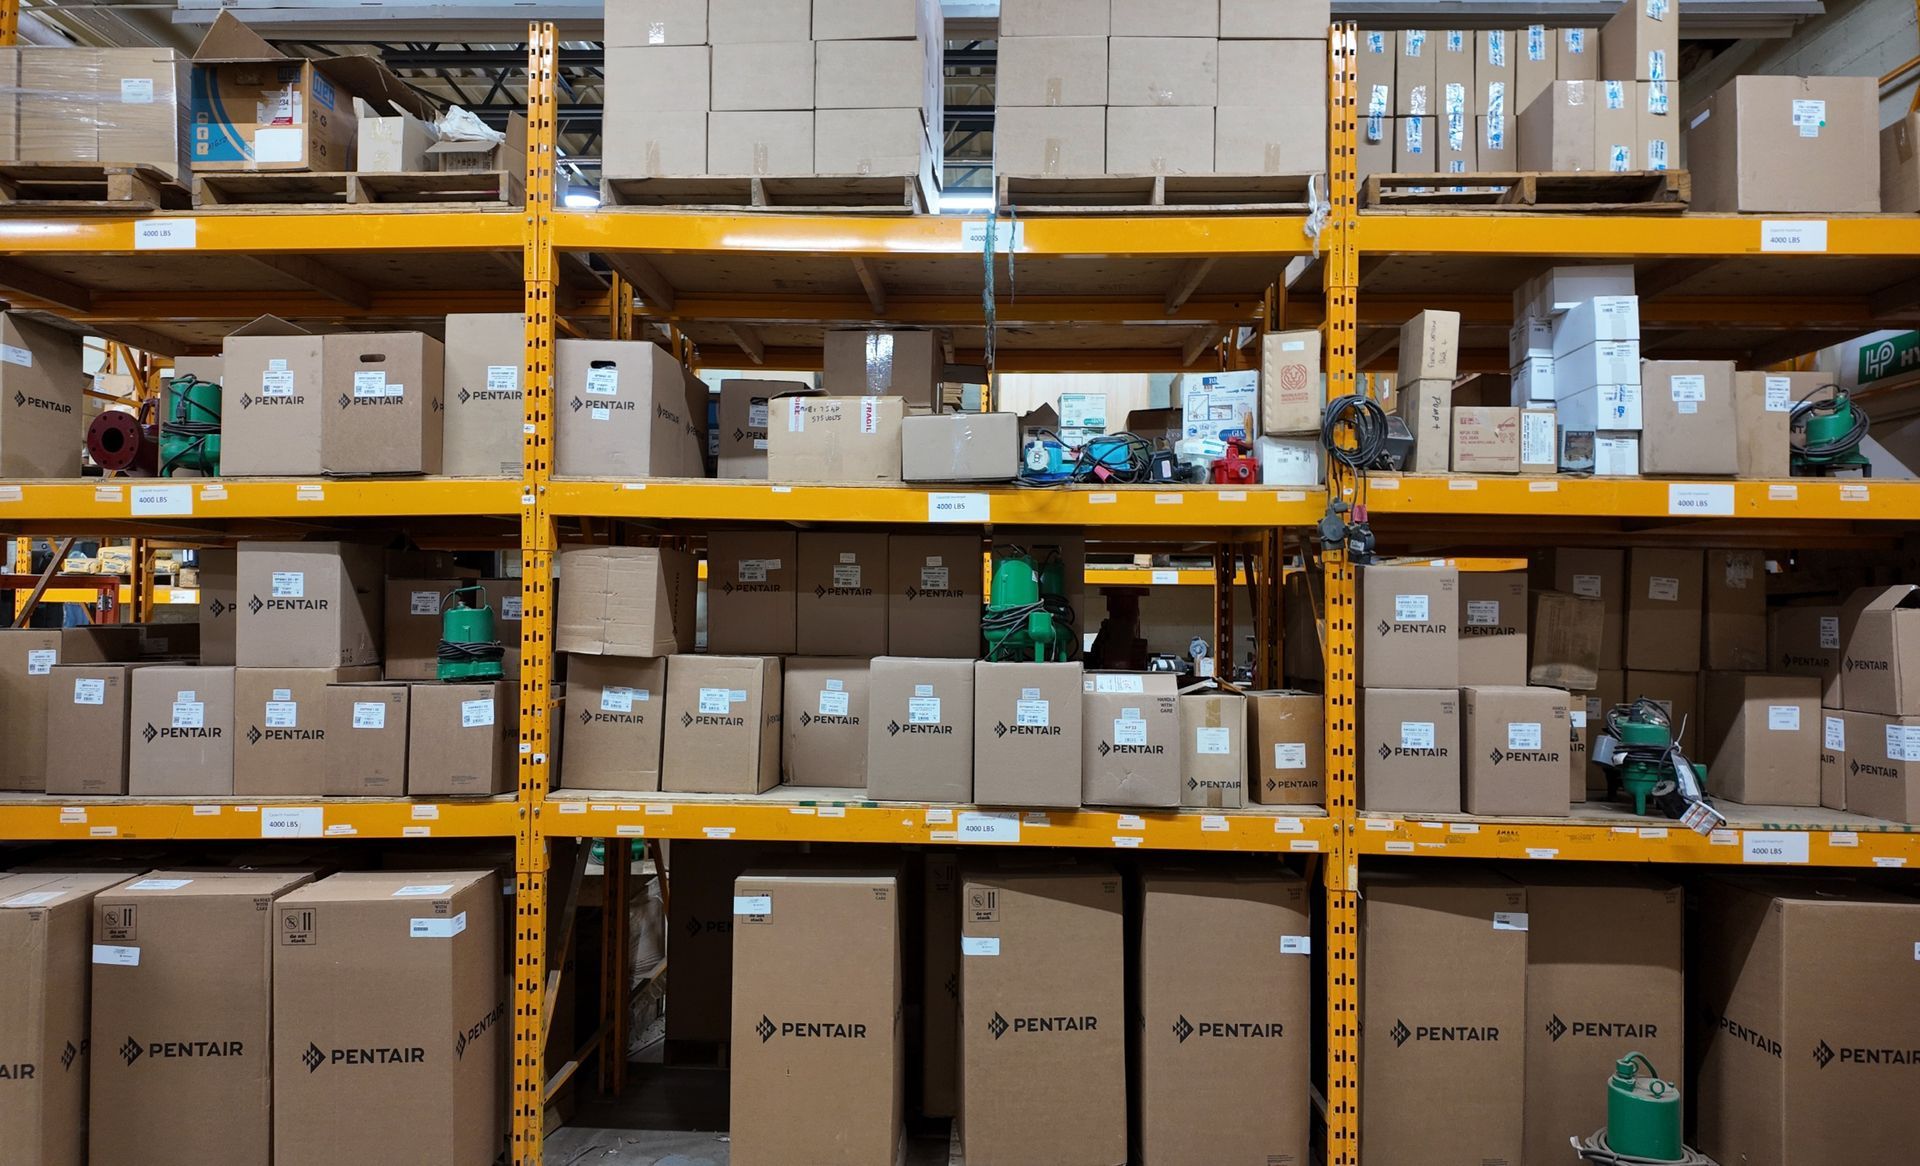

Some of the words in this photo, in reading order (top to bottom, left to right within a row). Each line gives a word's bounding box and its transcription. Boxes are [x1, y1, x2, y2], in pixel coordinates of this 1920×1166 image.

[473, 391, 522, 400] PENTAIR
[255, 396, 304, 405] PENTAIR
[354, 396, 403, 405] PENTAIR
[586, 400, 634, 410] PENTAIR
[28, 397, 71, 414] PENTAIR
[663, 409, 679, 424] PENTAIR
[139, 496, 154, 504] 4000
[156, 496, 167, 504] LBS
[1677, 500, 1694, 508] 4000
[1696, 500, 1708, 508] LBS
[736, 583, 781, 592] PENTAIR
[828, 587, 872, 595] PENTAIR
[919, 589, 964, 597] PENTAIR
[267, 599, 328, 611] PENTAIR
[1394, 624, 1446, 633] PENTAIR
[1464, 626, 1516, 635] PENTAIR
[1792, 656, 1829, 667] PENTAIR
[1855, 660, 1888, 670] PENTAIR
[595, 714, 643, 723] PENTAIR
[699, 714, 744, 726] PENTAIR
[814, 716, 859, 725] PENTAIR
[161, 728, 221, 737] PENTAIR
[902, 724, 952, 735] PENTAIR
[1010, 726, 1060, 735] PENTAIR
[266, 730, 324, 739] PENTAIR
[1113, 745, 1163, 753] PENTAIR
[1395, 747, 1447, 756] PENTAIR
[1507, 752, 1558, 761] PENTAIR
[1861, 764, 1897, 778] PENTAIR
[1200, 780, 1241, 788] PENTAIR
[1278, 780, 1318, 788] PENTAIR
[468, 1002, 504, 1045] PENTAIR
[1015, 1017, 1097, 1032] PENTAIR
[783, 1023, 866, 1038] PENTAIR
[1200, 1023, 1283, 1037] PENTAIR
[1417, 1027, 1499, 1040] PENTAIR
[1573, 1023, 1657, 1037] PENTAIR
[1719, 1015, 1782, 1058] PENTAIR
[150, 1042, 243, 1057] PENTAIR
[332, 1048, 424, 1064] PENTAIR
